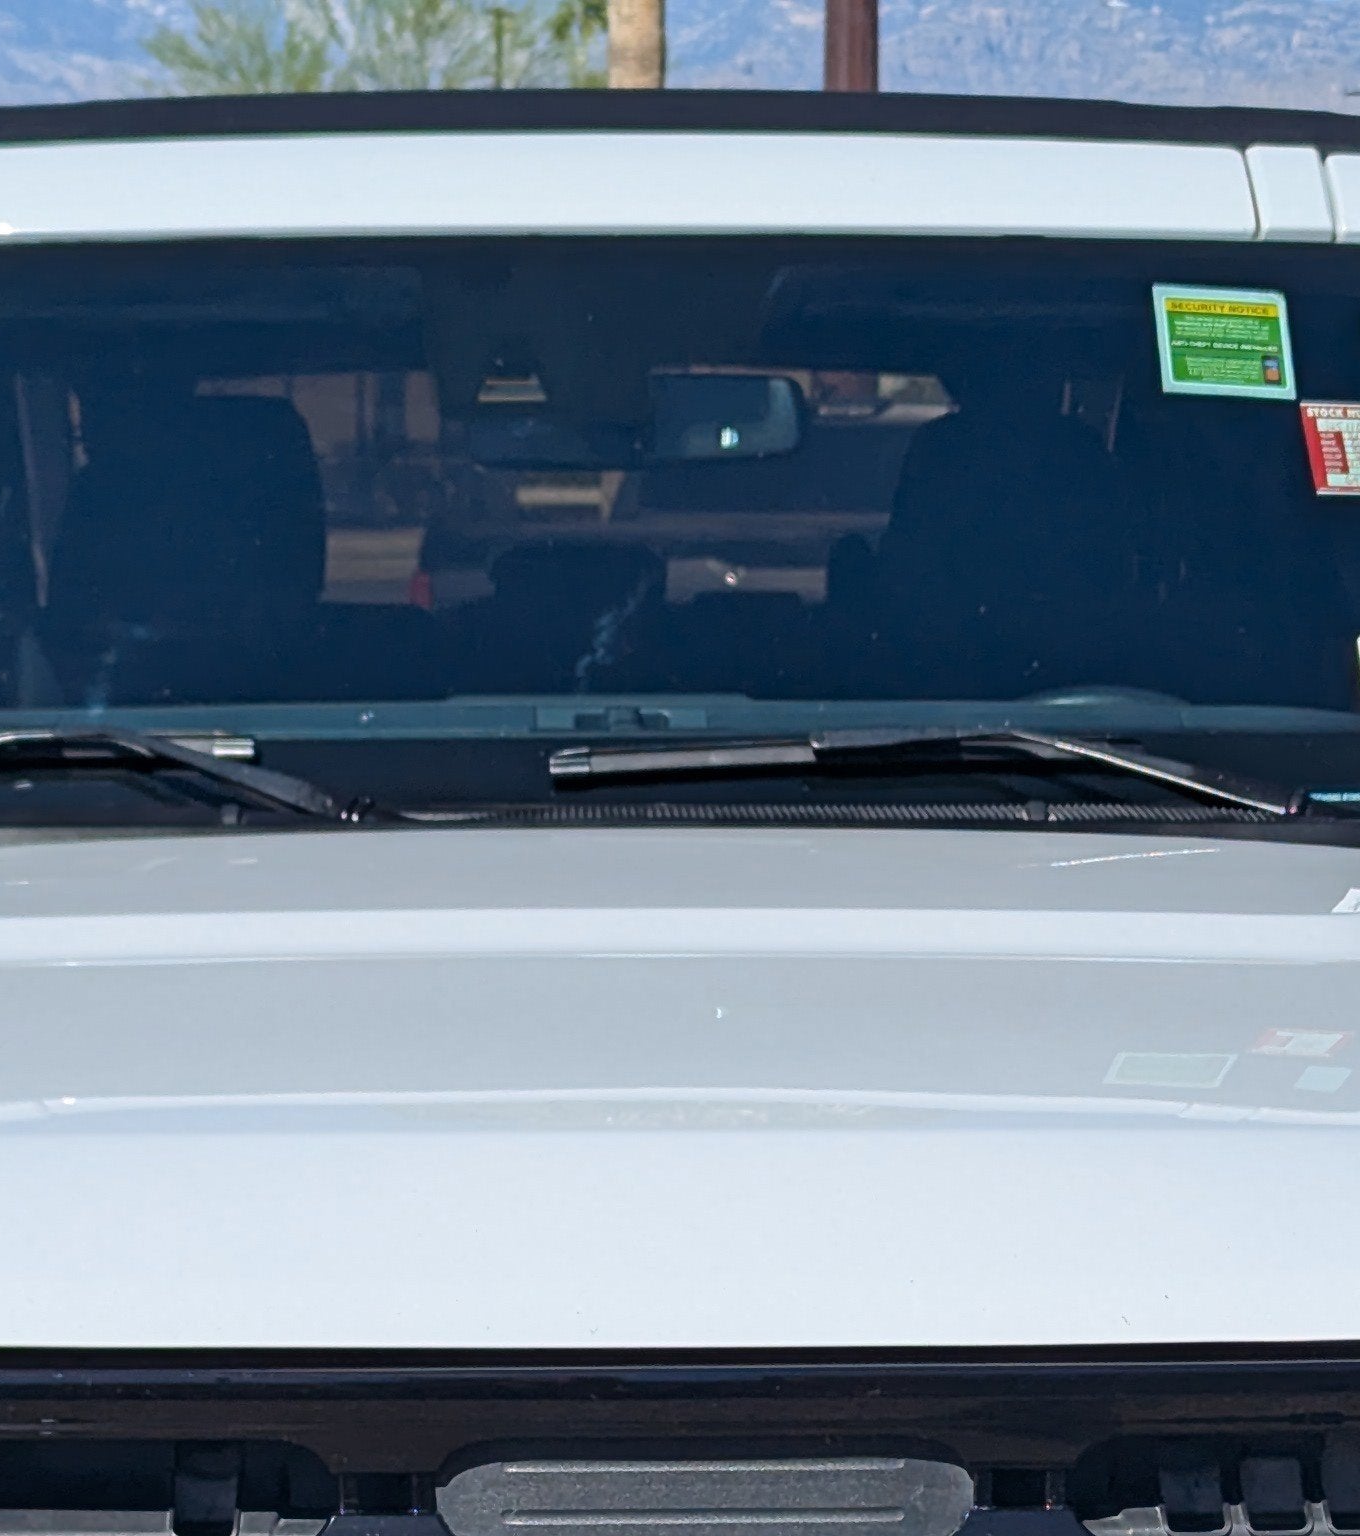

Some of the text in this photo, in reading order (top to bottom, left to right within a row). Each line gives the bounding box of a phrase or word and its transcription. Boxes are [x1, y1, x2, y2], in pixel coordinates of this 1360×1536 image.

[1171, 302, 1269, 315] SECURITY NOTICE
[1306, 407, 1343, 419] STOCK
